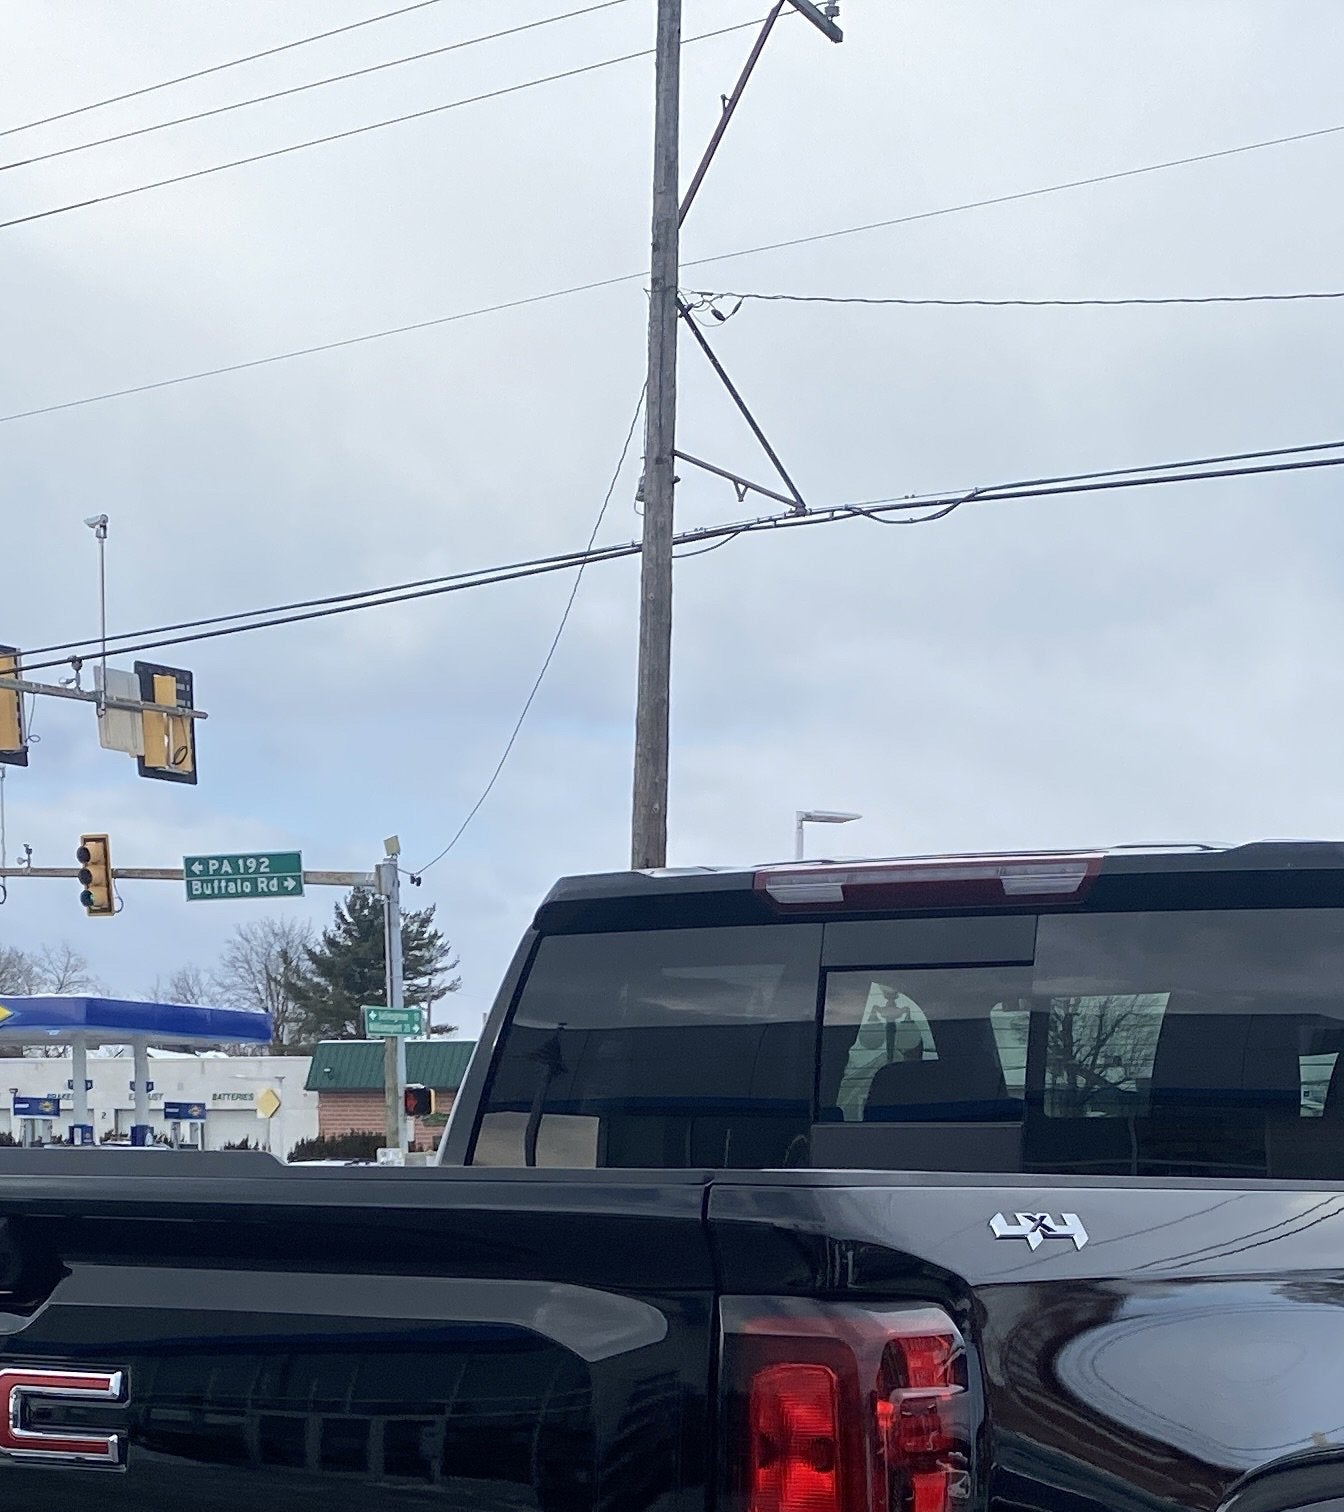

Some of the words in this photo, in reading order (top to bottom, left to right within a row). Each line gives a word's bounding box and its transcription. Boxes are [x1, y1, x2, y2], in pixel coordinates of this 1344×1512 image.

[208, 859, 233, 875] PA
[238, 857, 270, 873] 192
[191, 878, 252, 895] Buffalo
[257, 877, 279, 892] Rd
